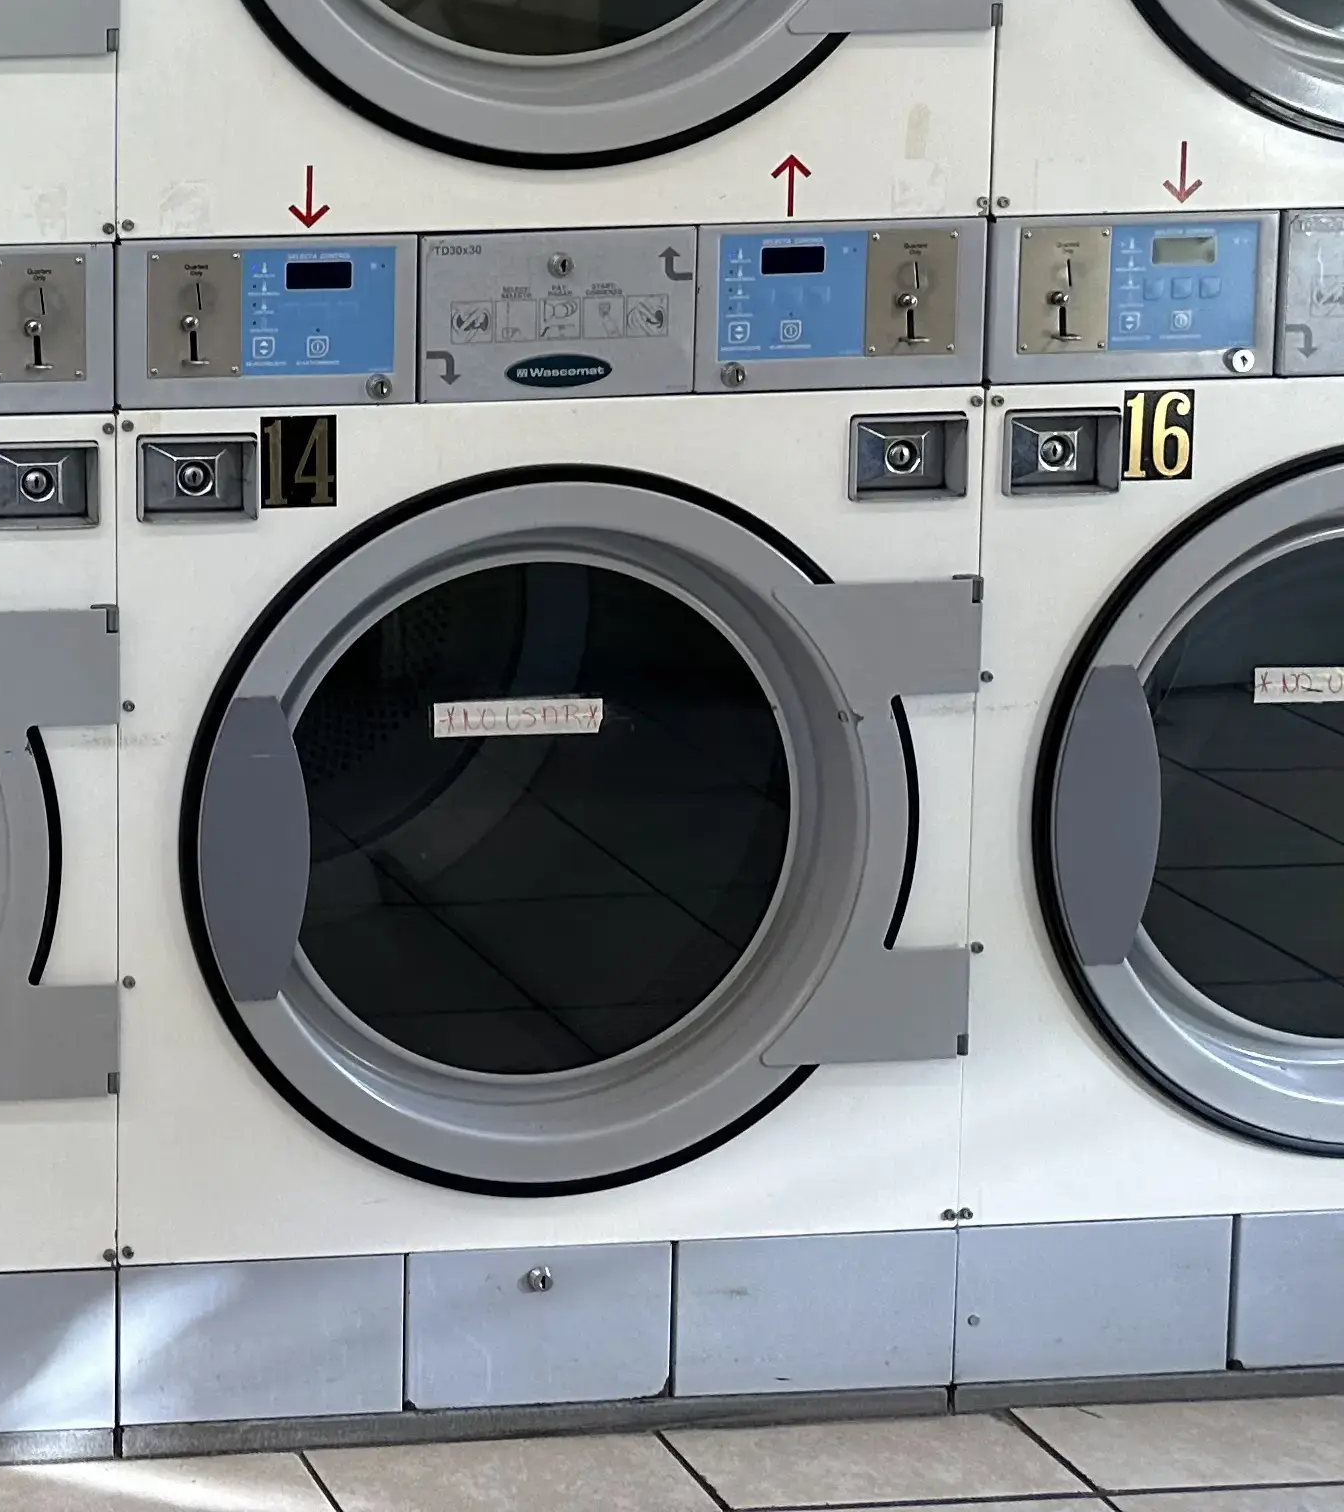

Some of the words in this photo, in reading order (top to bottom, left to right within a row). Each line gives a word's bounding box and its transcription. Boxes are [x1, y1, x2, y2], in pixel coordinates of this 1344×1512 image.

[434, 245, 482, 256] TD30x30
[529, 365, 605, 379] Wascomat
[1123, 390, 1192, 479] 16
[263, 417, 335, 505] 14
[462, 707, 496, 732] NO
[505, 704, 583, 731] USAR
